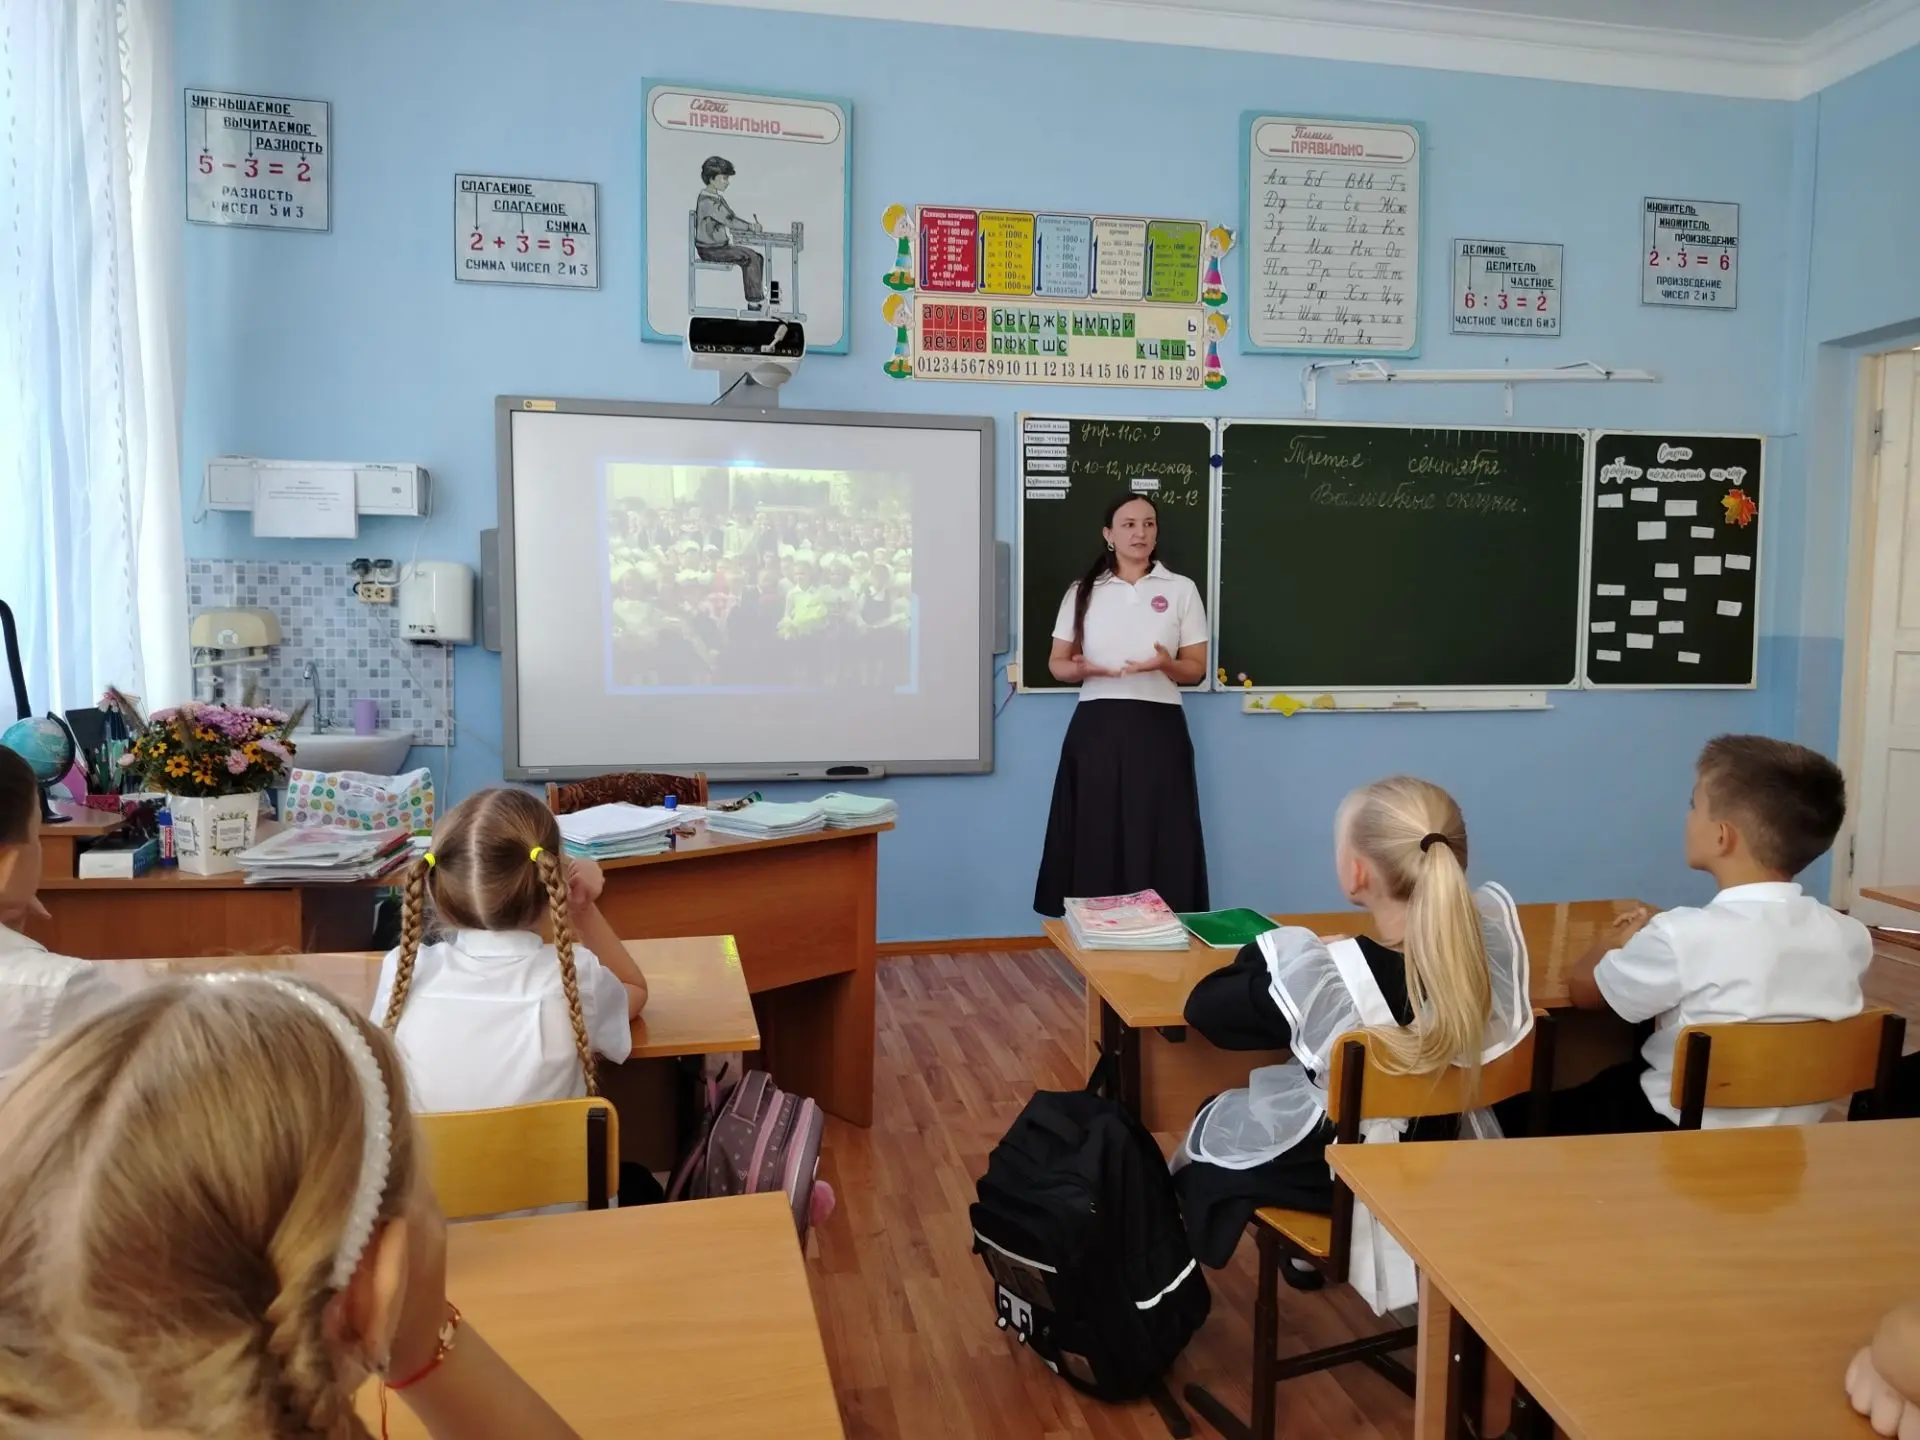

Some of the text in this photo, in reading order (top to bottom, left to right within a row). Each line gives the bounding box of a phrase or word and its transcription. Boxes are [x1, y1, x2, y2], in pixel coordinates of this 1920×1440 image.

[192, 94, 291, 115] УМЕНЬШАЕМОЕ
[223, 116, 311, 135] ВЫЧИТАЕМОЕ
[689, 112, 781, 134] ПРАВИЛЬНО
[1291, 126, 1334, 141] Пиши
[256, 137, 323, 153] РАЗНОСТЬ
[1291, 140, 1364, 156] ПРАВИЛЬНО
[199, 155, 213, 174] 5
[244, 158, 258, 178] 3
[297, 162, 311, 182] 2
[222, 186, 293, 201] РАЗНОСТЬ
[461, 180, 533, 195] СЛАГАЕМОЕ
[270, 204, 277, 217] 5
[283, 206, 290, 217] И
[296, 206, 304, 218] 3
[494, 200, 566, 214] СЛАГАЕМОЕ
[1646, 202, 1696, 214] МНОЖИТЕЛЬ
[546, 220, 587, 233] СУММА
[1659, 218, 1710, 231] МНОЖИТЕЛЬ
[470, 232, 484, 251] 2
[516, 235, 529, 253] 3
[561, 237, 575, 256] 5
[1675, 233, 1738, 246] ПРОИЗВЕДЕНИЕ
[1462, 244, 1506, 256] ДЕЛИМОЕ
[466, 258, 588, 276] СУММА ЧИСЕЛ 2 И 3
[1486, 260, 1536, 273] ДЕЛИТЕЛЬ
[1649, 250, 1660, 266] 2
[1677, 252, 1687, 268] 3
[1719, 254, 1730, 271] 6
[1510, 277, 1554, 288] ЧАСТНОЕ
[1656, 276, 1722, 289] ПРОИЗВЕДЕНИЕ
[1464, 292, 1476, 309] 6
[1497, 294, 1508, 310] 3
[1536, 295, 1547, 312] 2
[1661, 290, 1690, 300] ЧИСЕЛ
[1694, 290, 1700, 301] 2
[1710, 291, 1716, 301] 3
[1455, 316, 1496, 326] ЧАСТНОЕ
[1501, 317, 1533, 328] ЧИСЕЛ
[1006, 360, 1020, 376] 10
[1025, 361, 1037, 376] 11
[1043, 361, 1057, 377] 12
[1062, 361, 1075, 377] 13
[1080, 363, 1093, 378] 14
[1098, 364, 1111, 379] 15
[1116, 364, 1129, 379] 16
[1134, 365, 1147, 380] 17
[1152, 365, 1165, 380] 18
[1169, 365, 1183, 381] 19
[1186, 366, 1200, 381] 20
[1081, 423, 1115, 447] упр.
[1152, 426, 1161, 442] 9
[1284, 435, 1364, 479] Третье
